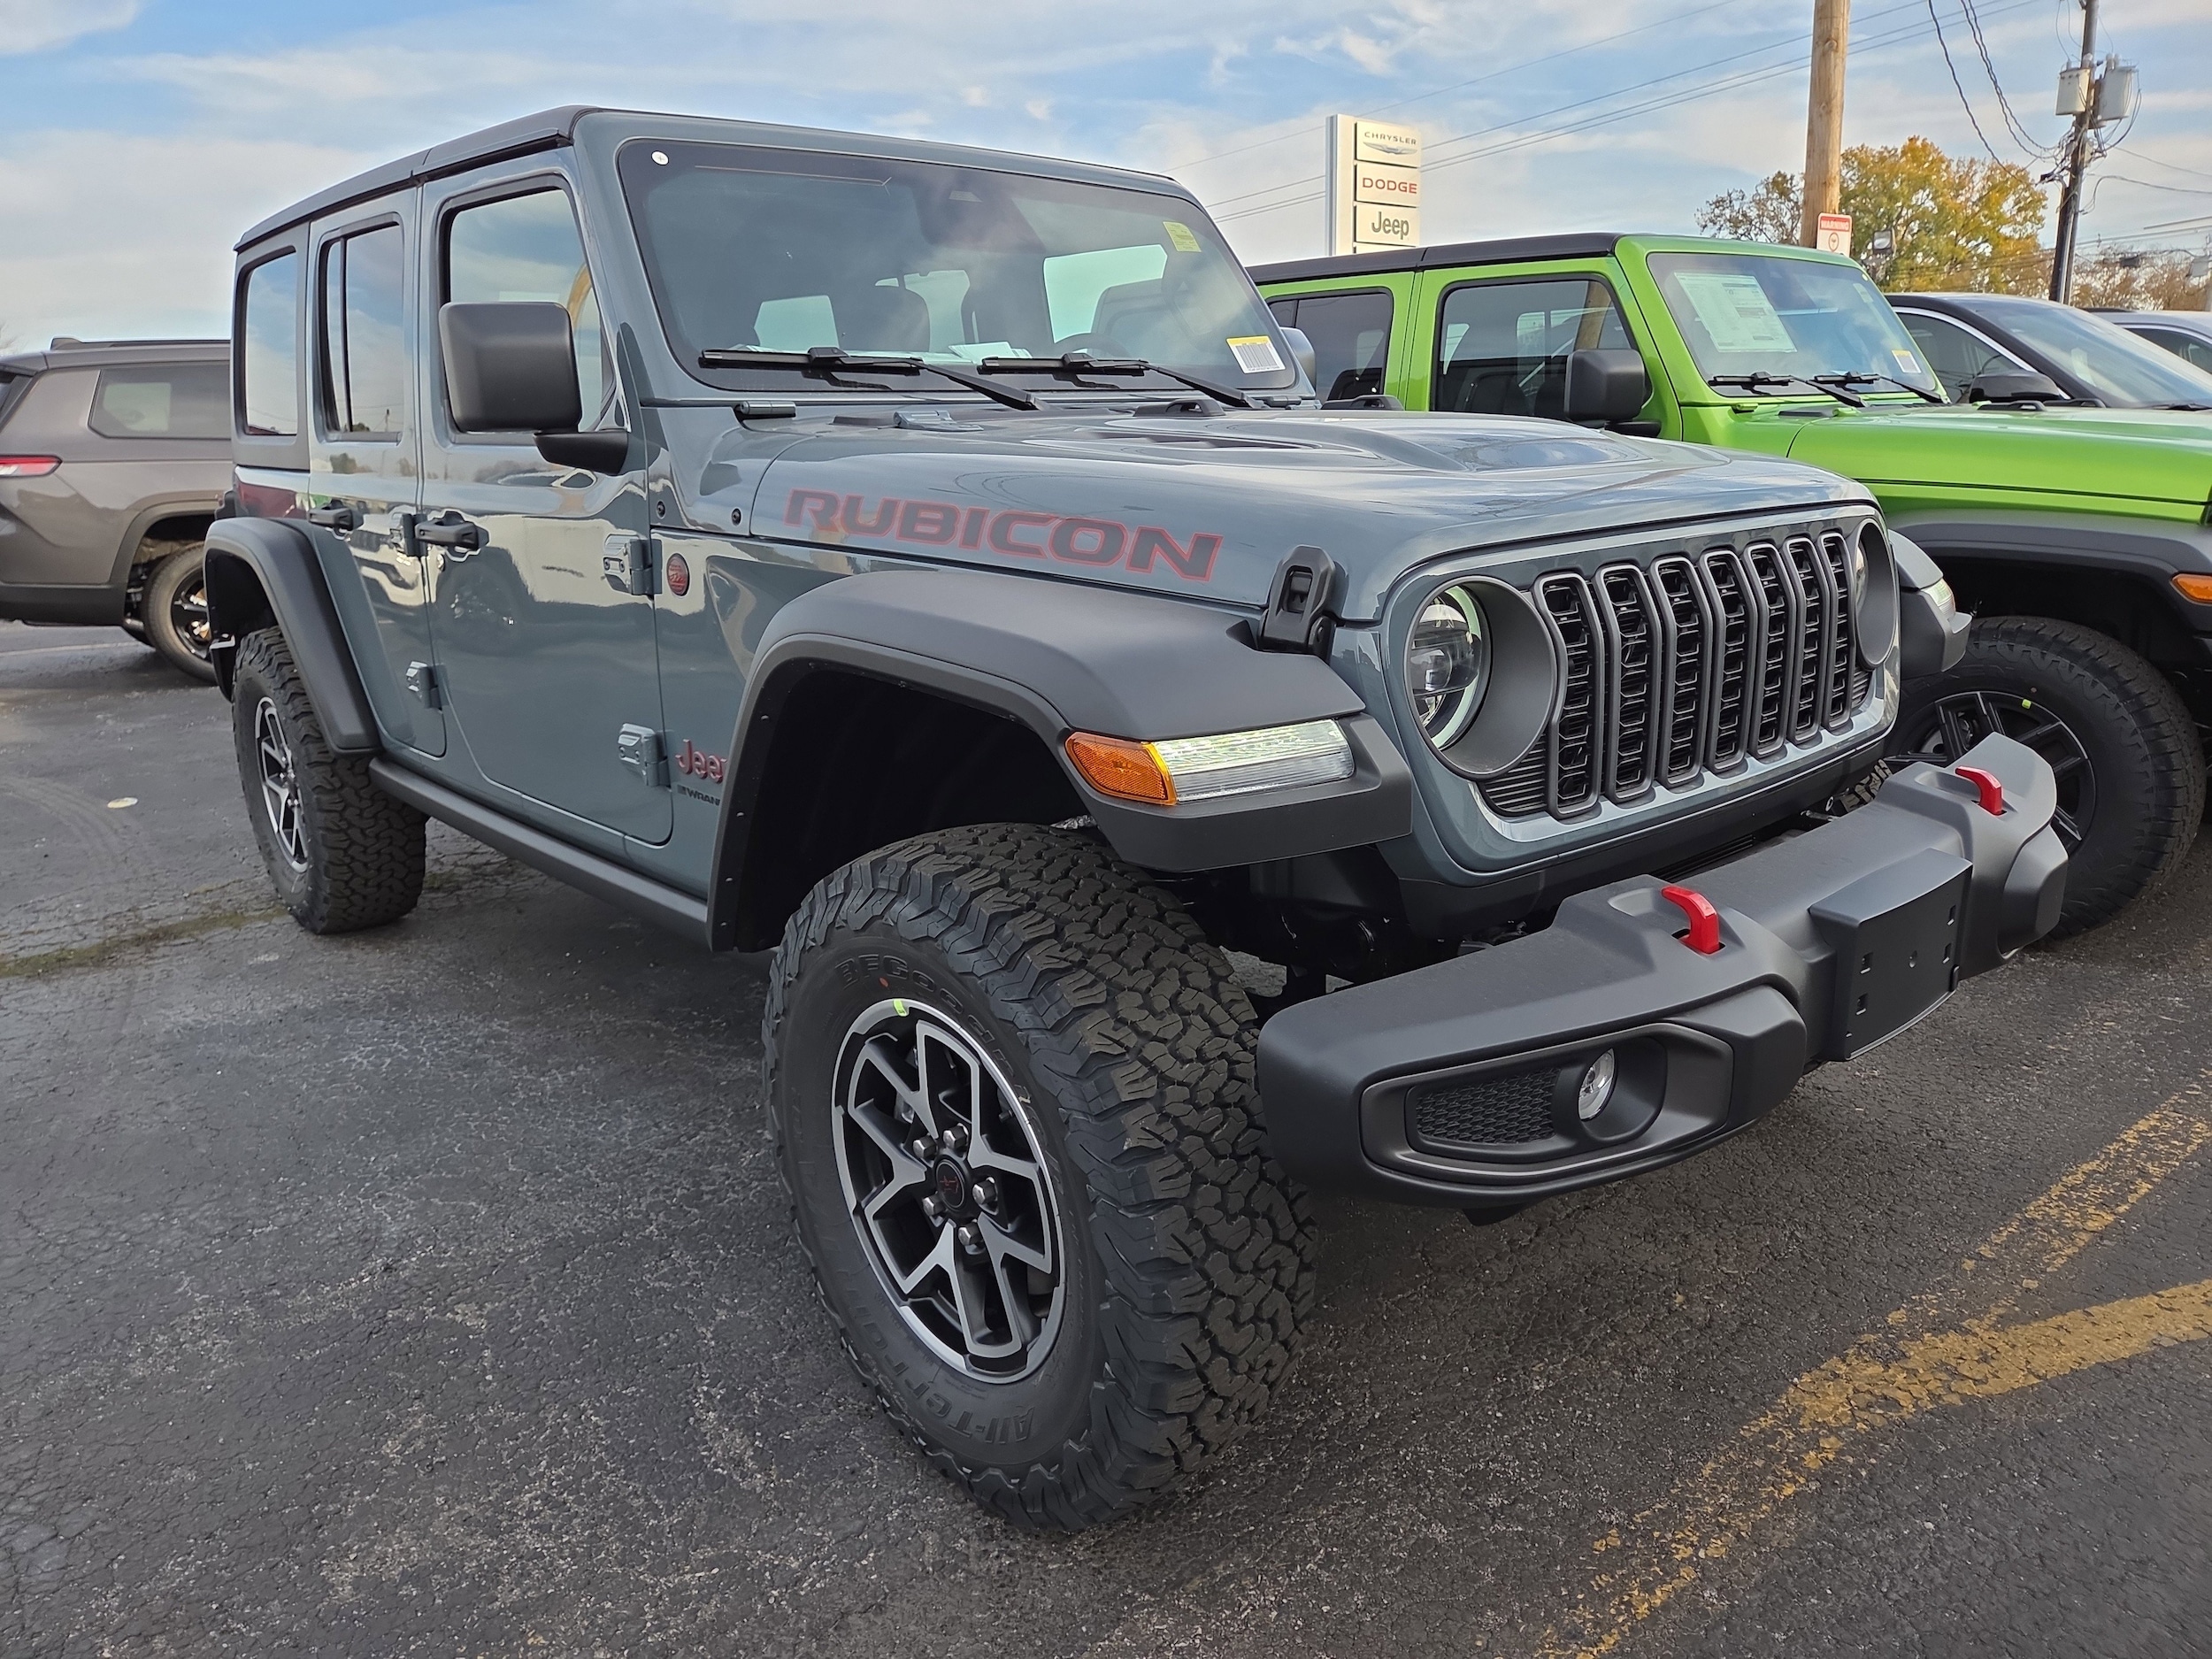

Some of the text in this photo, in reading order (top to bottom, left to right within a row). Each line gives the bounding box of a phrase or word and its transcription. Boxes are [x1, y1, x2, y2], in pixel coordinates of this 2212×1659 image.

[1364, 131, 1417, 145] CHRYSLER
[1363, 178, 1417, 195] DODGE
[1371, 211, 1409, 241] Jeep
[784, 488, 1224, 582] RUBICON
[675, 738, 727, 784] Jee
[686, 787, 721, 807] WRAN
